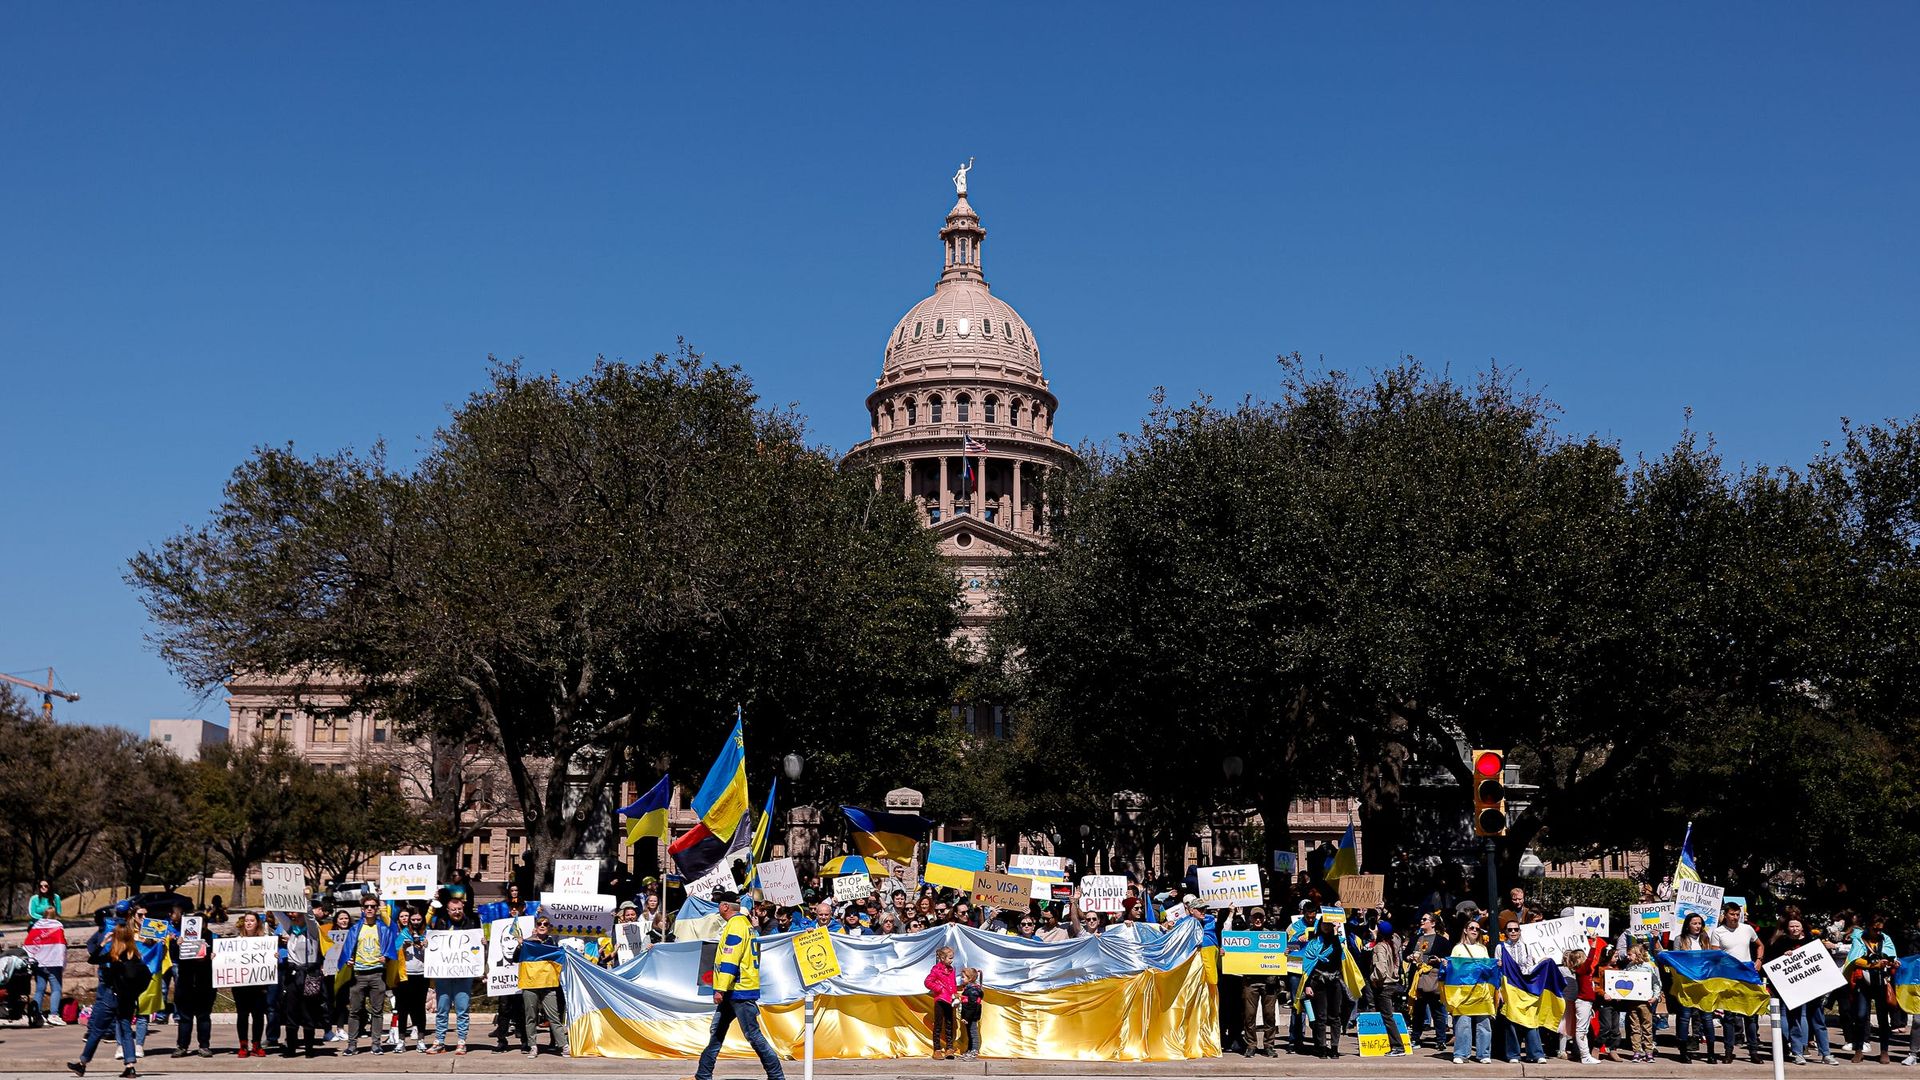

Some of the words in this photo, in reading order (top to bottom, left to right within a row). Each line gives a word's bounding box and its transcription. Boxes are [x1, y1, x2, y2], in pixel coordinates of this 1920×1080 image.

[389, 861, 431, 871] Слава
[1022, 857, 1034, 866] NO
[1038, 858, 1059, 867] WAR
[267, 867, 302, 882] STOP
[1212, 869, 1246, 882] SAVE
[563, 877, 583, 887] ALL
[689, 878, 714, 896] ZONE
[764, 880, 781, 889] Zone
[782, 882, 797, 890] over
[837, 877, 861, 886] STOP
[978, 878, 991, 889] No
[996, 880, 1019, 894] VISA
[1021, 888, 1028, 896] &
[841, 891, 870, 900] UKRAINE
[1201, 884, 1260, 901] UKRAINE
[1683, 881, 1692, 892] NO
[1692, 882, 1705, 895] FLY
[1705, 886, 1720, 899] ZONE
[265, 893, 306, 910] MADMAN
[985, 894, 999, 904] MC
[550, 903, 579, 911] STAND
[581, 904, 604, 912] WITH
[1633, 905, 1671, 914] SUPPORT
[554, 913, 598, 921] UKRAINE!
[1535, 920, 1562, 937] STOP
[1634, 922, 1670, 931] UKRAINE
[218, 940, 248, 952] NATO
[429, 934, 470, 951] STOP
[800, 936, 824, 946] SANCTIONS
[1223, 937, 1250, 946] NATO
[240, 952, 267, 965] SKY
[440, 950, 471, 963] WAR
[1770, 963, 1782, 972] NO
[1782, 950, 1807, 966] FLIGHT
[1783, 962, 1803, 975] ZONE
[1803, 953, 1824, 965] OVER
[216, 968, 249, 985] HELP
[249, 966, 277, 984] NOW
[427, 965, 439, 977] IN
[818, 967, 835, 976] PUTIN
[1788, 964, 1822, 984] UKRAINE
